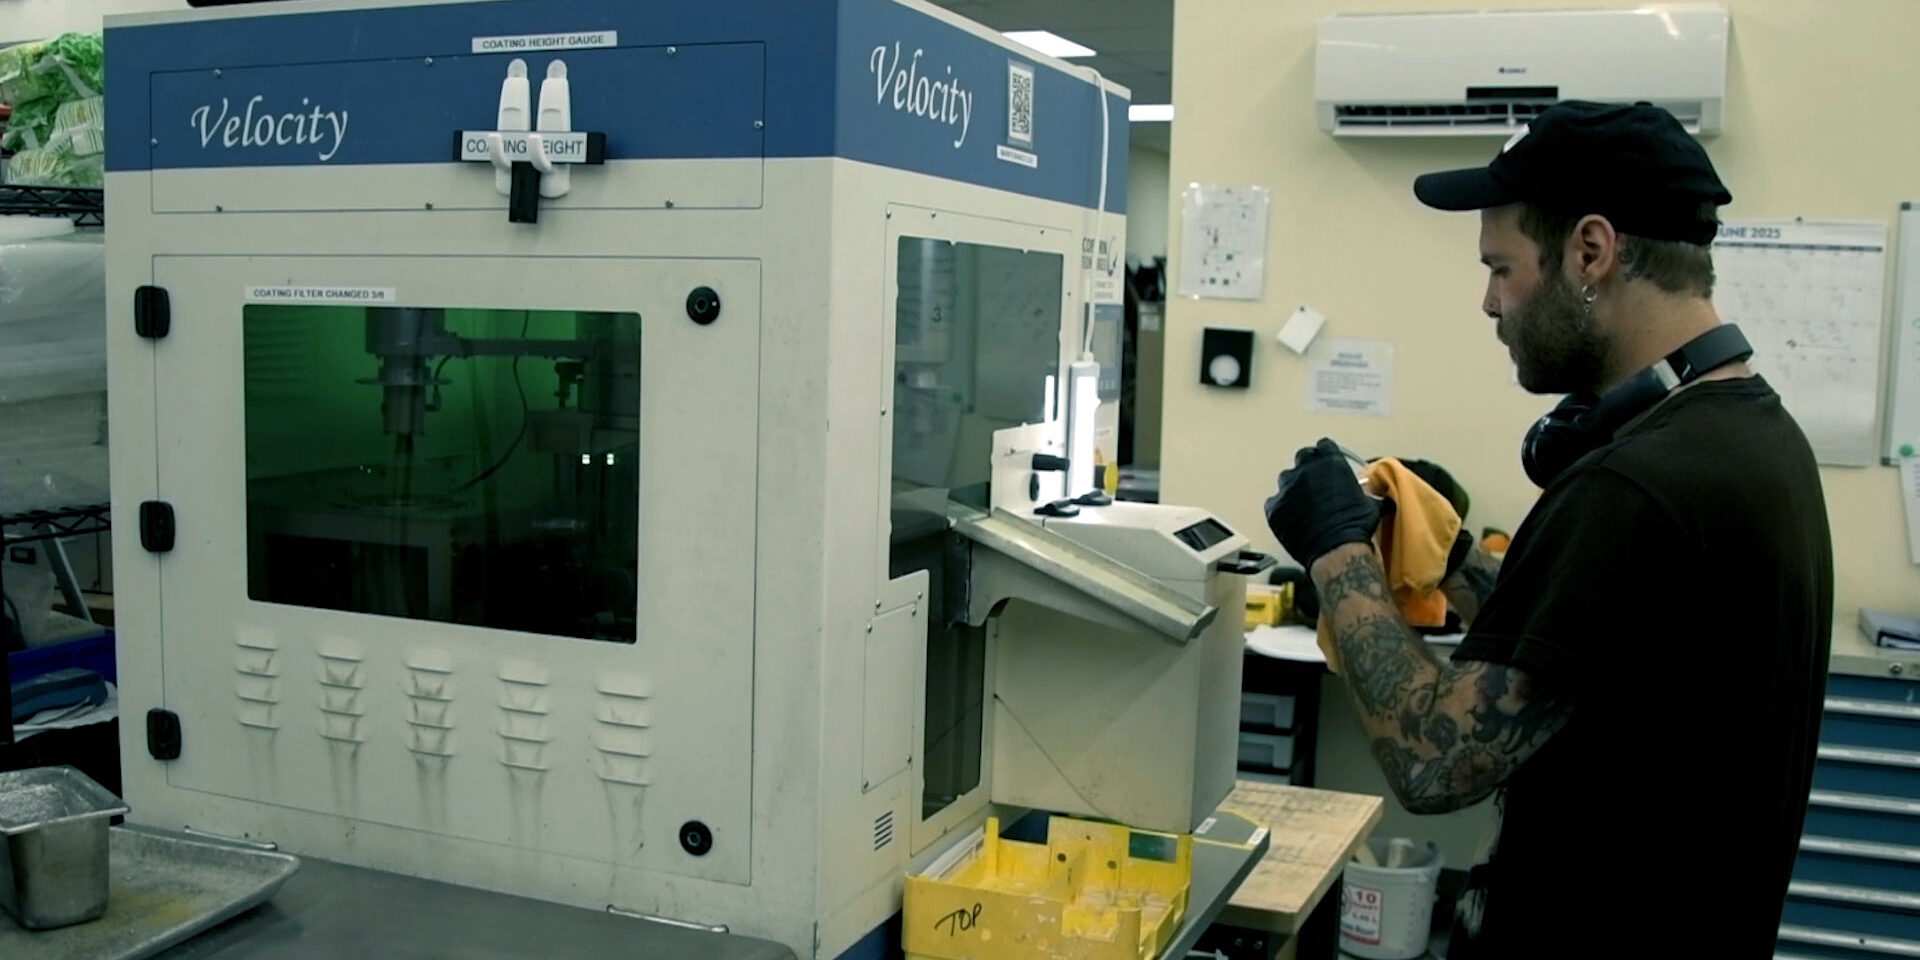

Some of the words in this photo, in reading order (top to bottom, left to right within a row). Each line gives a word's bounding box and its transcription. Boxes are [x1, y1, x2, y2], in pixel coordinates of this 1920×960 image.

[482, 38, 527, 49] COATING
[529, 37, 566, 48] HEIGHT
[568, 34, 605, 45] GAUGE
[869, 40, 973, 149] Velocity
[190, 94, 348, 161] Velocity
[466, 138, 528, 154] COING
[542, 139, 584, 155] EIGHT
[1751, 227, 1781, 239] 2025
[253, 288, 292, 298] COATING
[293, 288, 324, 298] FILTER
[325, 289, 370, 299] CHANGED
[1355, 890, 1377, 905] 10
[934, 902, 982, 937] TOP
